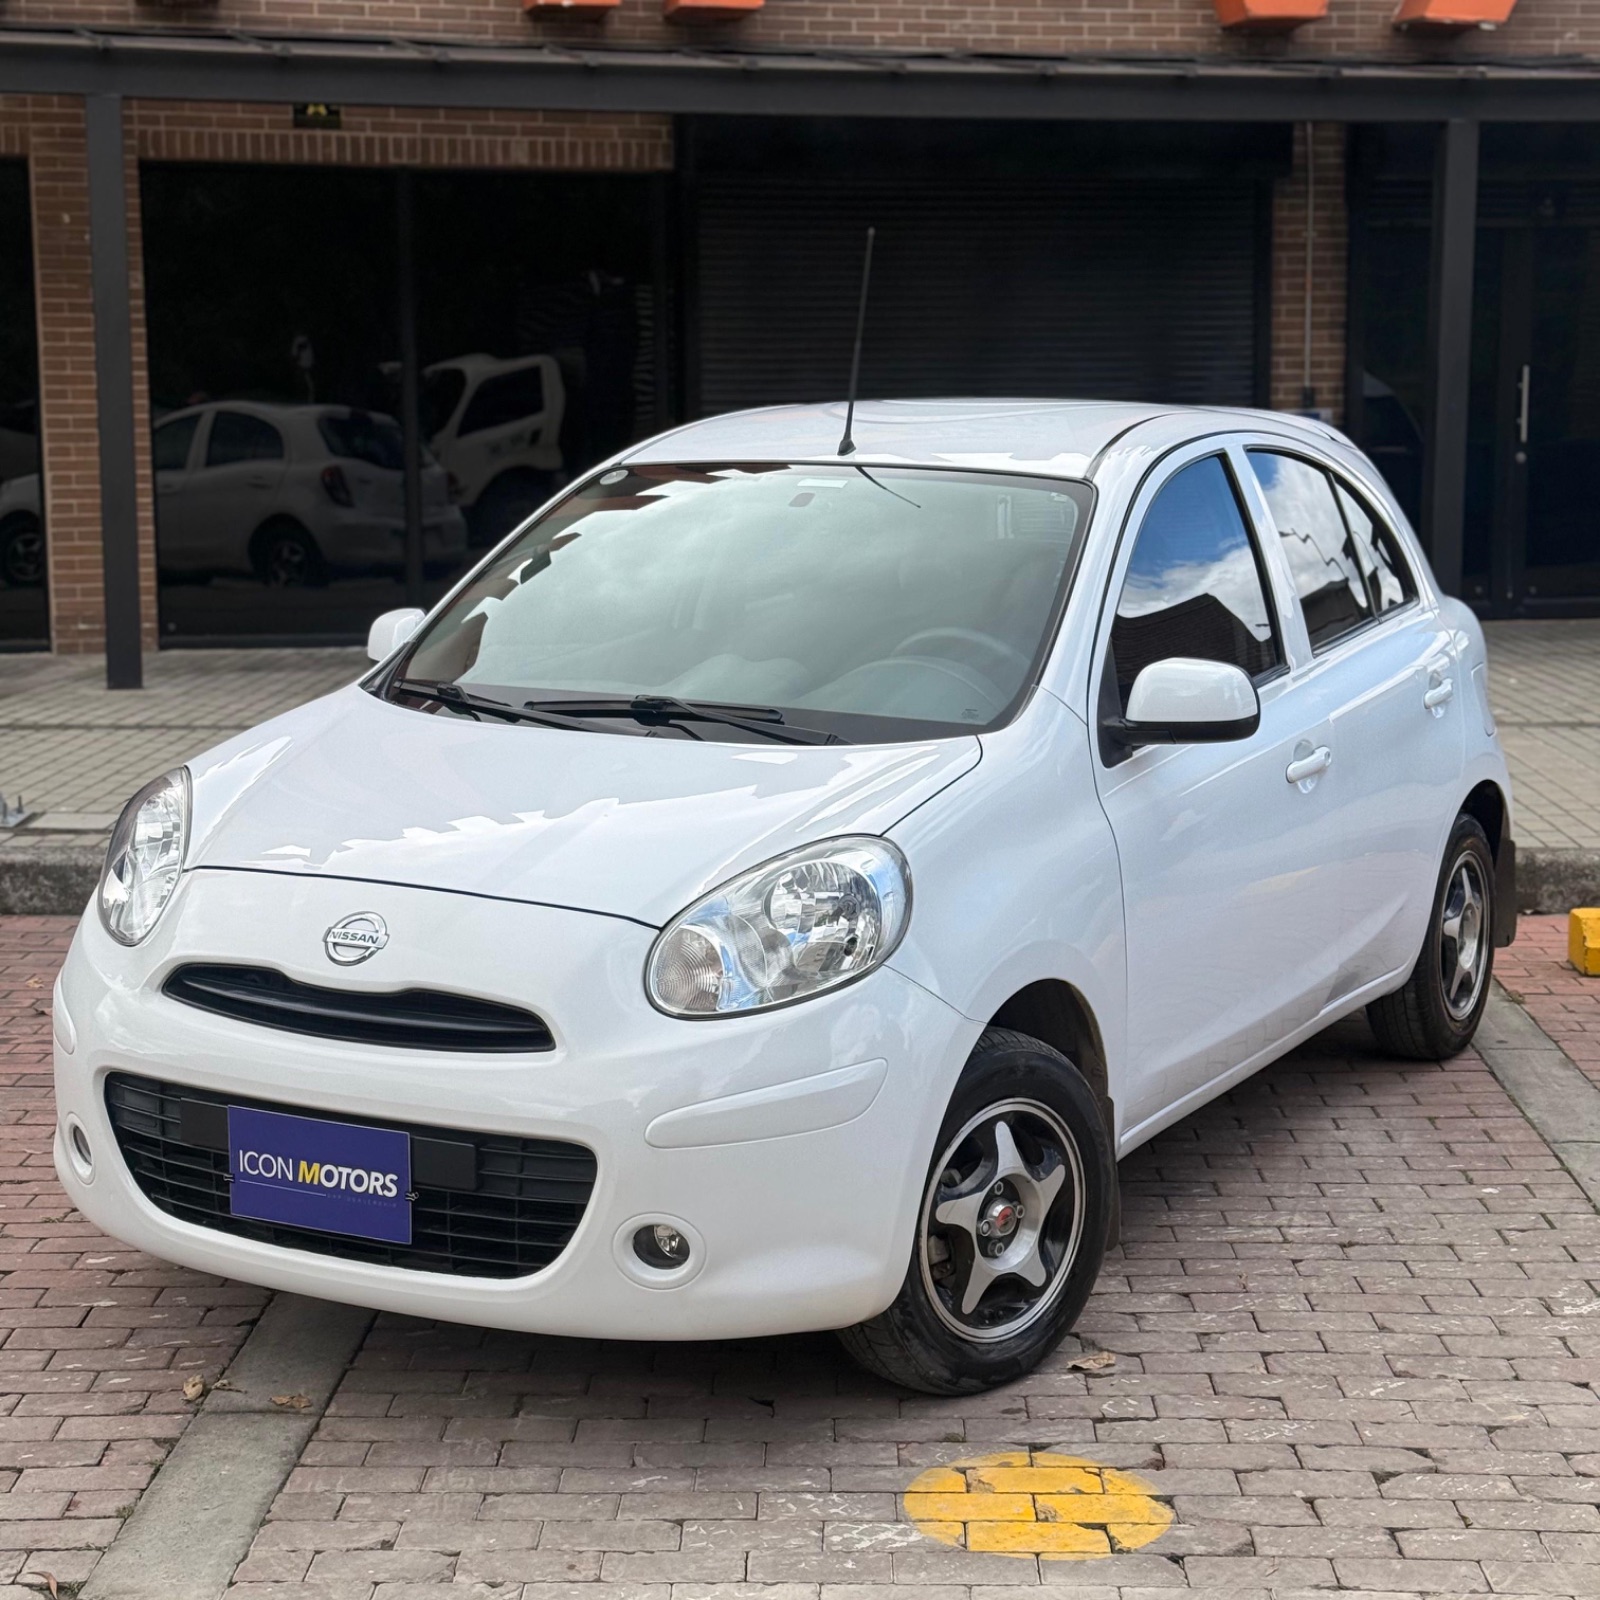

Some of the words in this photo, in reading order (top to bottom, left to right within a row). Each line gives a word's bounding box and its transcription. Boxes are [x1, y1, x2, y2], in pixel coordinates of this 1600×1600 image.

[330, 931, 379, 944] NISSAN
[239, 1149, 293, 1181] ICON
[298, 1160, 398, 1198] MOTORS
